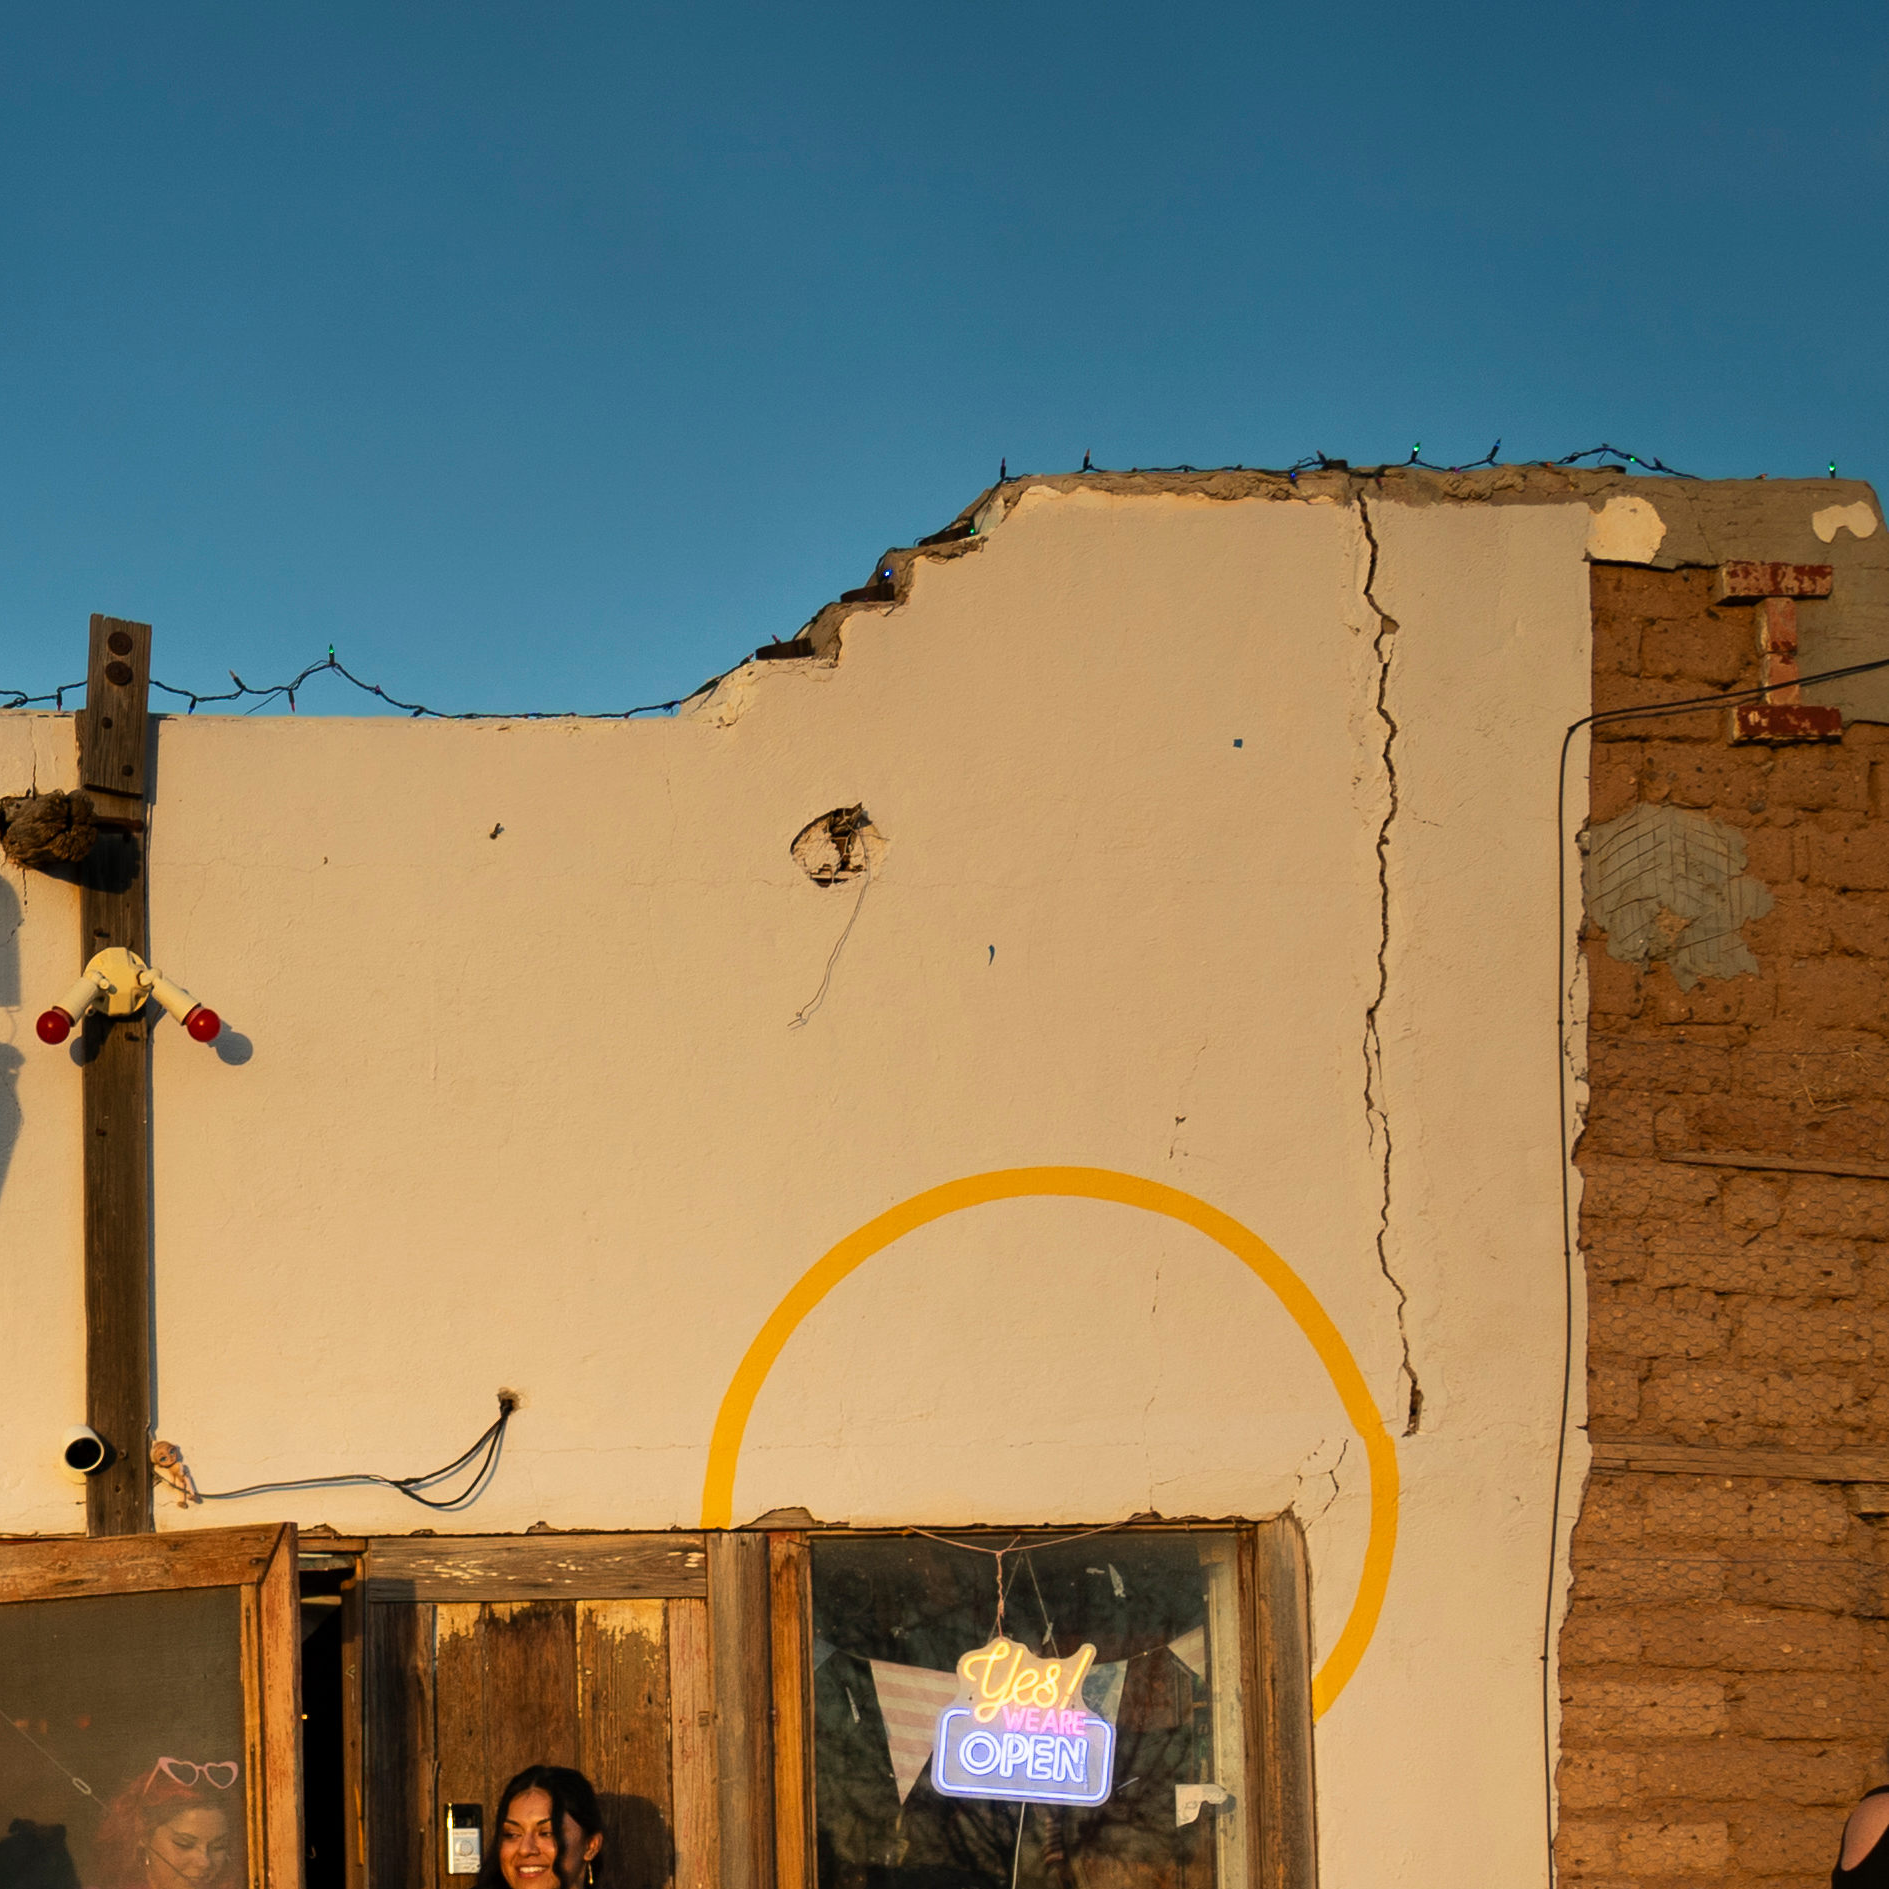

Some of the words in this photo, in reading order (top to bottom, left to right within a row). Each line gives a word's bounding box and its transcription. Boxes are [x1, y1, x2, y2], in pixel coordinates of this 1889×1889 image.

[963, 1641, 1093, 1724] Yes!
[1002, 1705, 1040, 1733] WE
[1040, 1708, 1087, 1736] ARE
[959, 1730, 1089, 1784] OPEN
